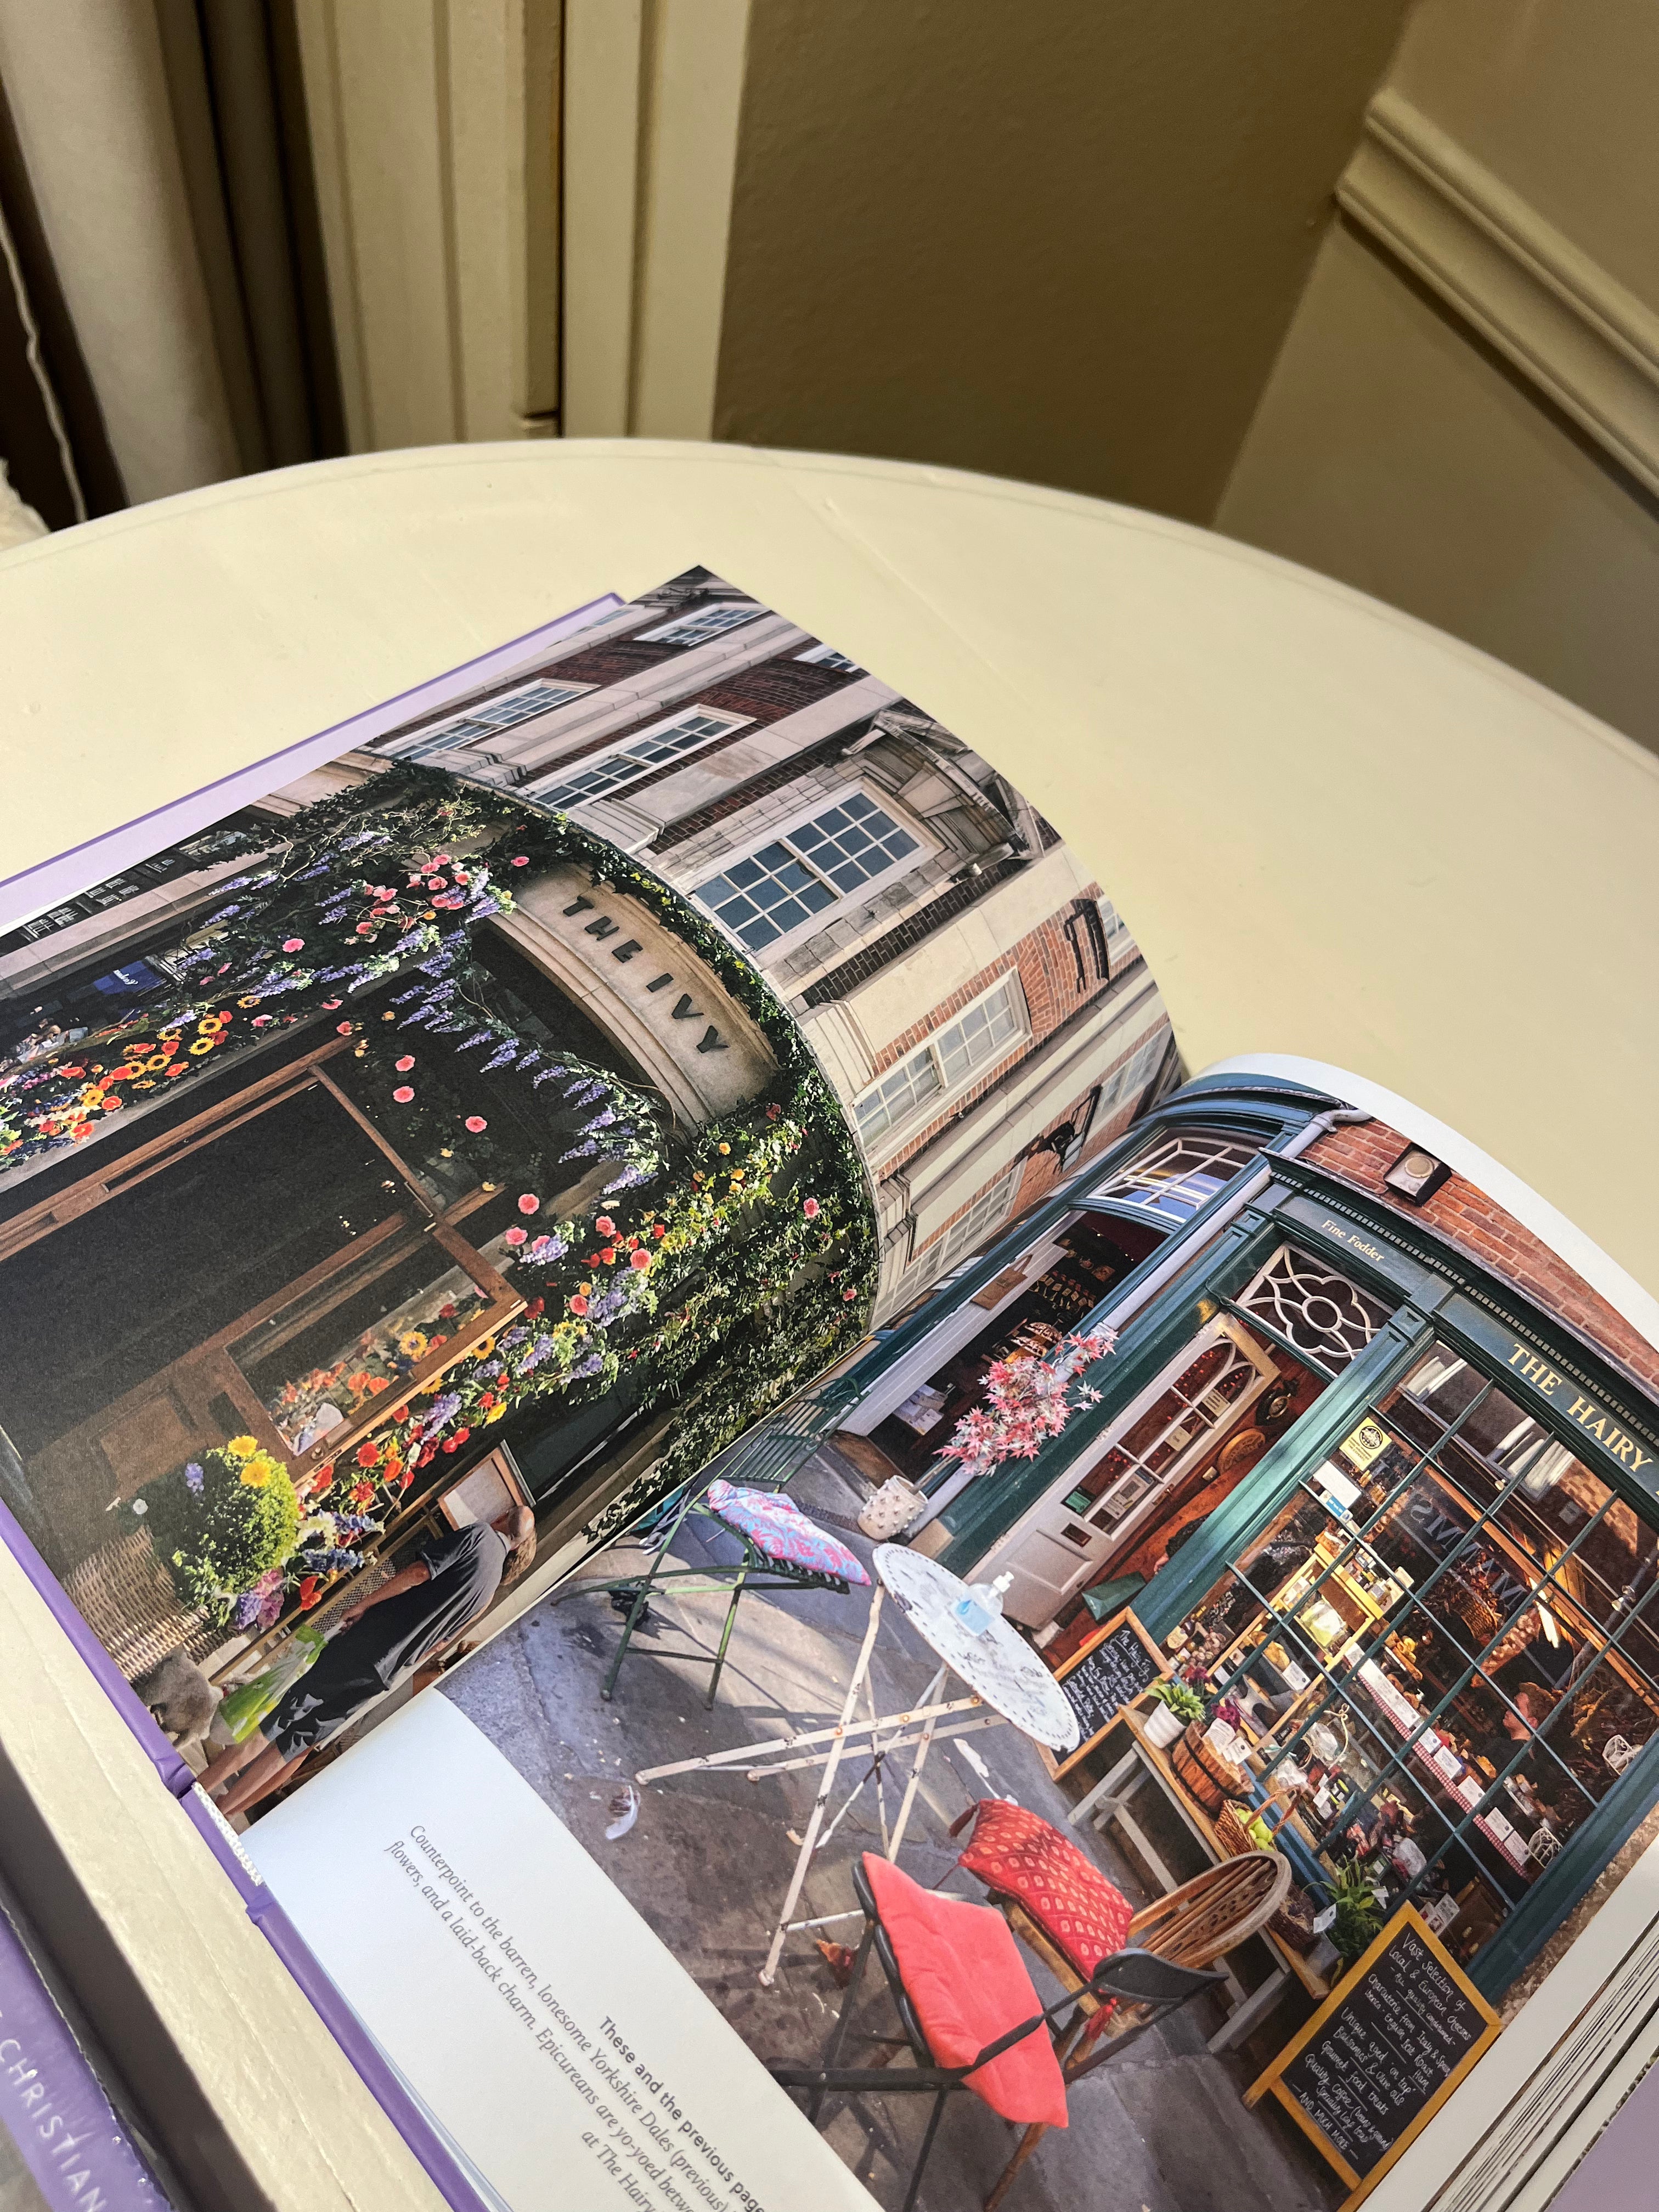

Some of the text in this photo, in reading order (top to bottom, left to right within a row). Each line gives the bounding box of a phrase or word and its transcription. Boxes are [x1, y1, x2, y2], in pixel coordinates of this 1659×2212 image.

[563, 896, 729, 1054] THE IVY
[1321, 1220, 1384, 1262] Fine Fodder
[1508, 1344, 1653, 1472] THE HAIRY
[411, 1826, 473, 1902] Counterpoint
[470, 1901, 484, 1916] to
[482, 1917, 503, 1939] the
[499, 1937, 537, 1989] barren,
[538, 1984, 591, 2051] lonesome
[590, 2048, 642, 2113] Yorkshire
[639, 2111, 674, 2152] Dales
[1389, 1945, 1411, 1972] Local
[1410, 1970, 1420, 1978] &
[1418, 1980, 1447, 2016] European
[1403, 1933, 1424, 1960] Vast
[1454, 2000, 1466, 2011] of
[384, 1841, 693, 2212] flowers, and a laid-back charm. Epicureans are yo-yoed betw
[1341, 2007, 1366, 2039] Unique
[1368, 2042, 1389, 2066] aged
[1400, 2014, 1415, 2033] from
[1417, 2030, 1432, 2055] Italy
[1430, 2050, 1439, 2058] &
[600, 2016, 635, 2063] These
[635, 2064, 664, 2094] and
[660, 2092, 681, 2120] the
[678, 2120, 733, 2182] previous
[1306, 2054, 1330, 2090] Quality
[1321, 2041, 1389, 2115] Gourmet food treats
[1365, 2062, 1378, 2074] &
[1413, 2070, 1429, 2091] Ham
[1300, 2092, 1349, 2149] AND MUCH MORE
[582, 2132, 599, 2148] at
[597, 2145, 622, 2176] The
